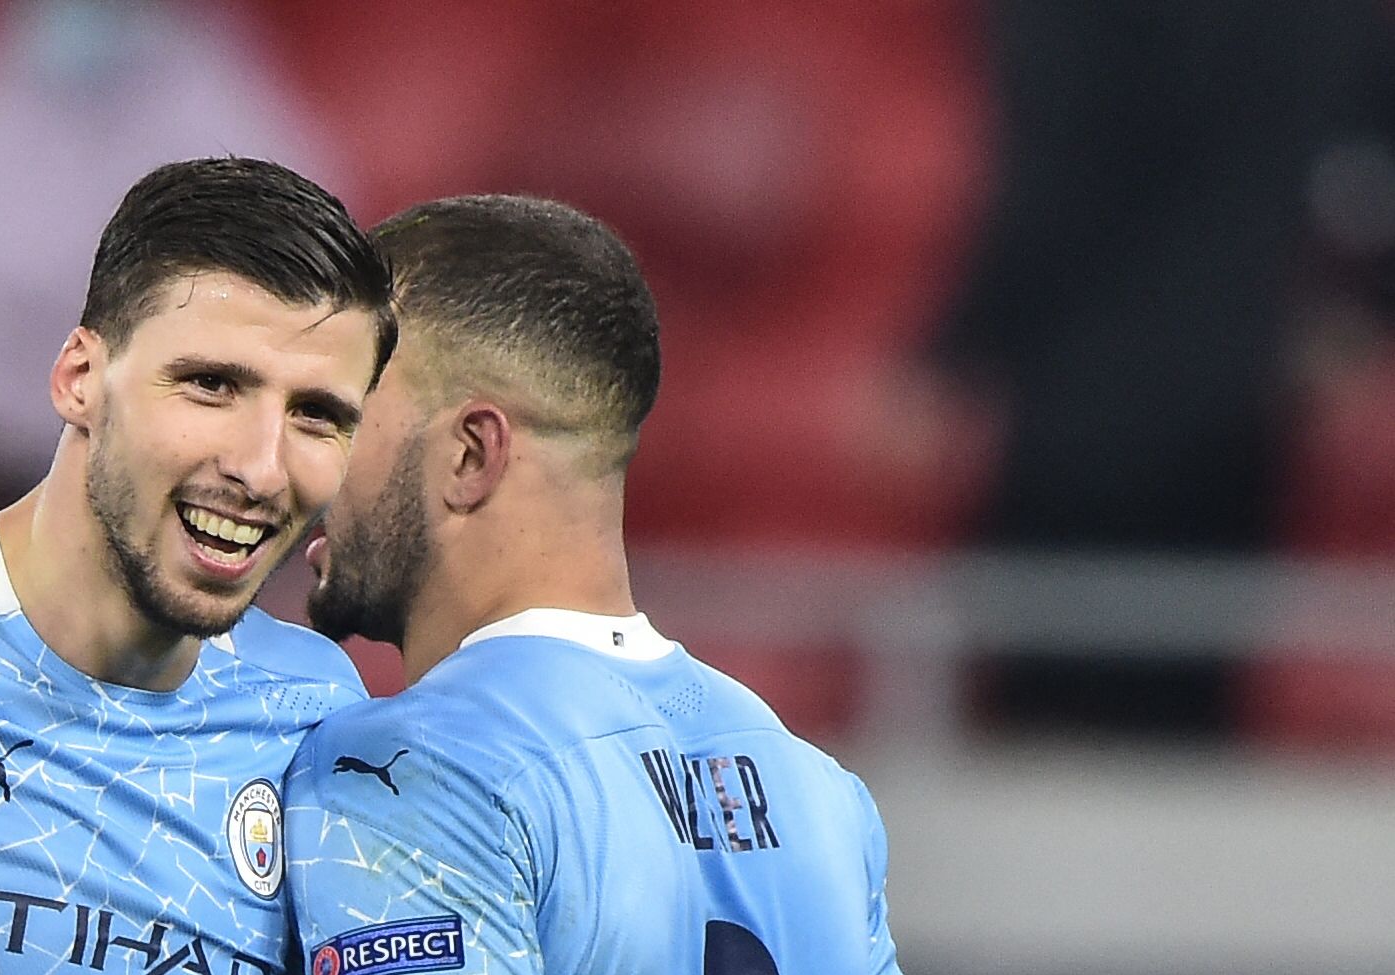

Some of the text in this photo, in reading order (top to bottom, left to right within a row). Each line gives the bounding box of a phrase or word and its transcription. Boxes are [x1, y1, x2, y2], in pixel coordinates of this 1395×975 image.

[233, 785, 281, 826] MANCHESTER
[640, 748, 780, 853] WLER
[254, 880, 271, 892] CITY
[343, 930, 460, 971] RESPECT
